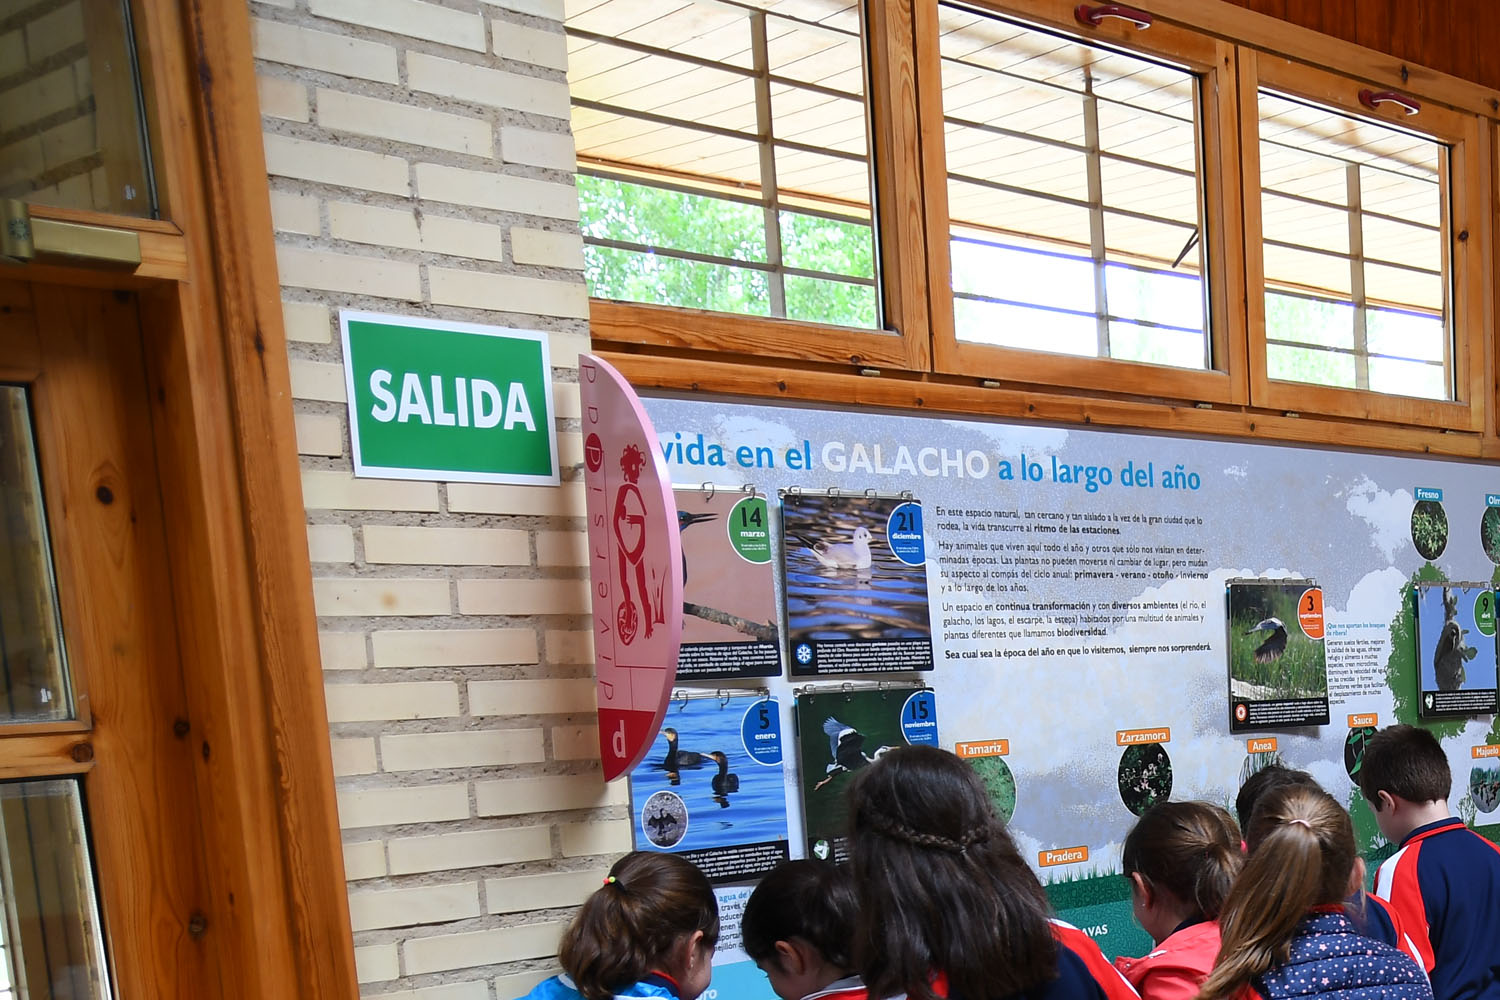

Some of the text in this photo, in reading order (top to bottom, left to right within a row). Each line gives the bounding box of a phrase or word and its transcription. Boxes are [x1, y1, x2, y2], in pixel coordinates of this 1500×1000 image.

[369, 369, 536, 432] SALIDA
[659, 432, 1201, 493] vida en el GALACHO a lo largo del año
[1418, 489, 1439, 499] Fresno
[741, 507, 762, 528] 14
[896, 512, 914, 531] 21
[936, 506, 945, 517] En
[948, 509, 963, 517] este
[965, 509, 992, 519] espacio
[994, 510, 1021, 519] natural,
[1024, 511, 1035, 519] tan
[1037, 512, 1064, 520] cercano
[1066, 513, 1070, 521] y
[1084, 513, 1106, 522] aislado
[1113, 513, 1118, 522] la
[1132, 514, 1140, 523] de
[1142, 514, 1147, 523] la
[1149, 516, 1163, 525] gran
[1164, 515, 1183, 524] ciudad
[1184, 518, 1195, 526] que
[1197, 516, 1203, 525] lo
[937, 522, 961, 531] rodea,
[963, 522, 969, 531] la
[972, 523, 985, 531] vida
[987, 523, 1024, 532] transcurre
[1026, 524, 1032, 532] al
[1034, 524, 1056, 533] ritmo
[1059, 524, 1068, 533] de
[1070, 525, 1079, 533] las
[942, 603, 954, 611] Un
[956, 603, 983, 613] espacio
[996, 602, 1030, 611] continua
[1032, 601, 1090, 611] transformación
[1092, 603, 1096, 612] y
[1112, 601, 1141, 610] diversos
[1142, 601, 1178, 609] ambientes
[1180, 601, 1188, 611] (el
[1201, 601, 1207, 609] el
[1307, 596, 1314, 611] 3
[1482, 598, 1489, 611] 9
[944, 630, 969, 642] plantas
[971, 629, 1007, 639] diferentes
[1009, 632, 1022, 640] que
[1024, 629, 1055, 638] llamamos
[945, 650, 960, 659] Sea
[962, 650, 978, 659] cual
[980, 650, 993, 658] sea
[994, 649, 1001, 658] la
[1003, 648, 1026, 659] época
[1028, 648, 1039, 656] del
[1041, 648, 1055, 656] año
[1067, 648, 1081, 658] que
[1082, 645, 1089, 655] lo
[1091, 645, 1126, 655] visitemos,
[1129, 644, 1157, 655] siempre
[911, 701, 929, 720] 15
[759, 709, 770, 729] 5
[904, 721, 936, 729] noviembre
[1353, 717, 1373, 725] Sauce
[612, 719, 626, 758] d
[1119, 731, 1167, 744] Zarzamora
[961, 744, 1003, 756] Tamariz
[1252, 741, 1272, 751] Anea
[1046, 850, 1082, 863] Pradera
[719, 894, 737, 903] agua
[721, 902, 740, 911] través
[1082, 924, 1108, 937] AVAS
